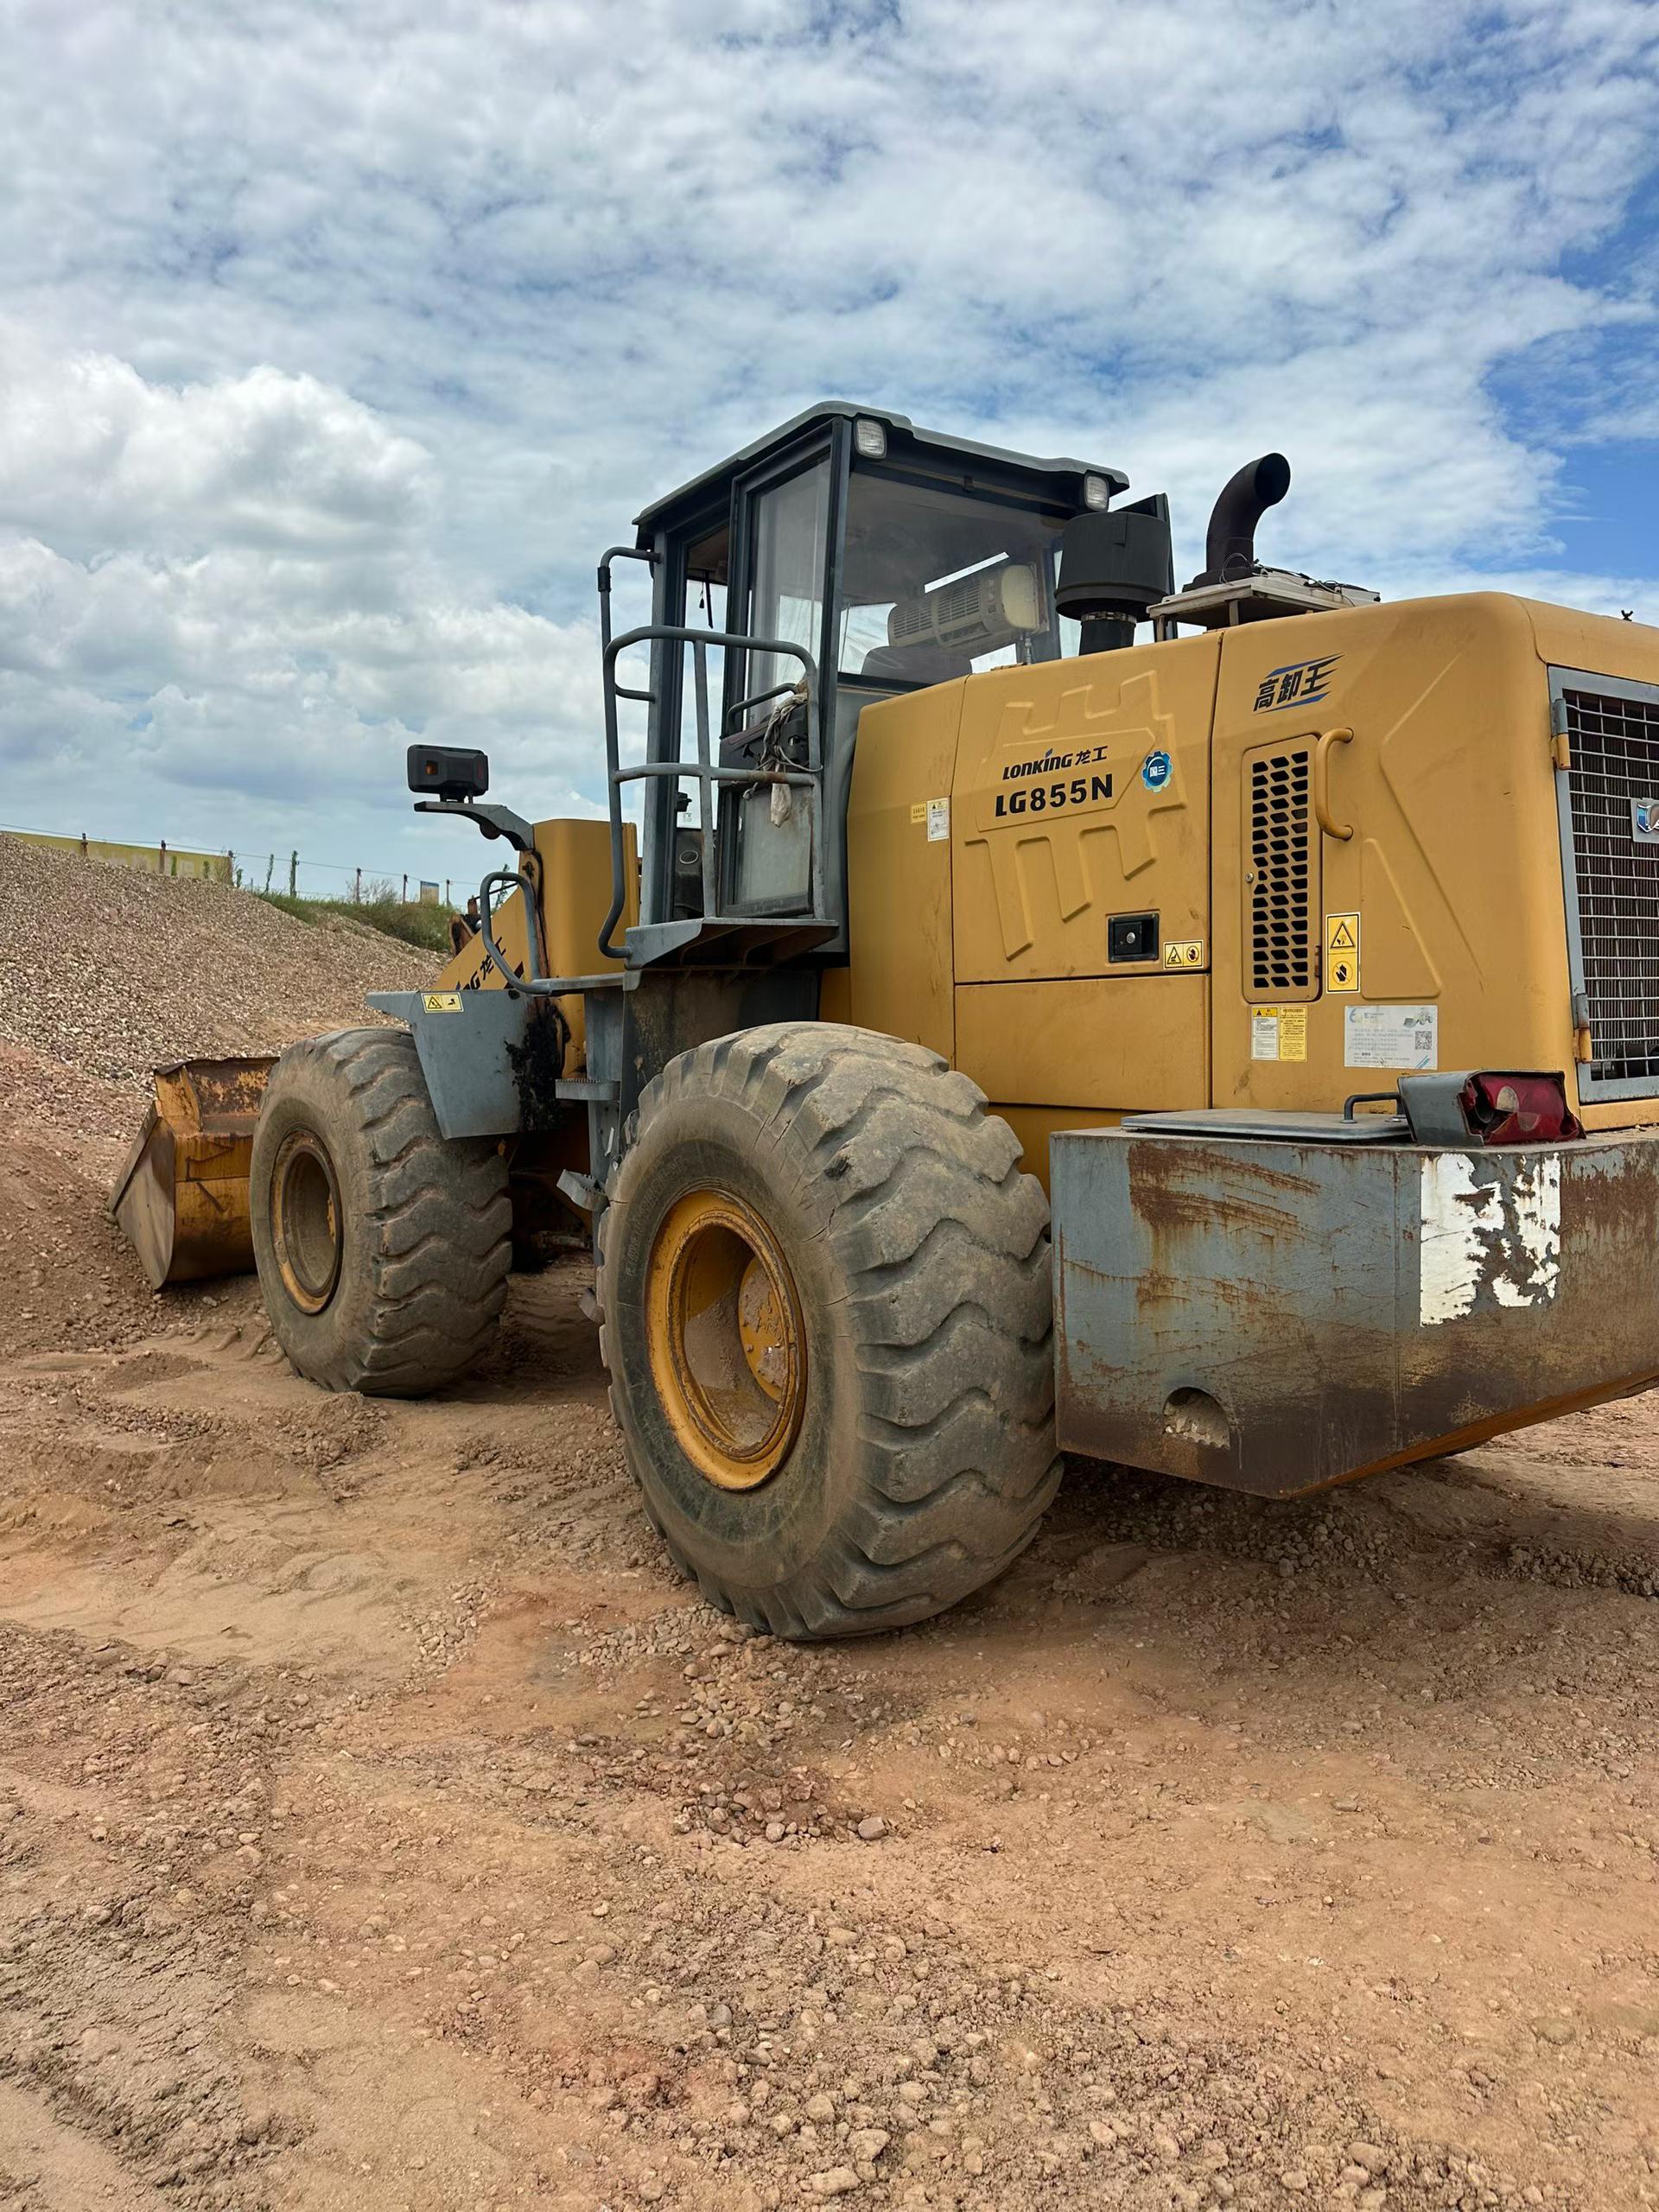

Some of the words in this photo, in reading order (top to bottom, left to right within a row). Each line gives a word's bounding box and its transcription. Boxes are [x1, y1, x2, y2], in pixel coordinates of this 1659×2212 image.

[1253, 654, 1345, 712] 高卸王
[1075, 746, 1108, 766] 龙工
[995, 773, 1113, 817] LG855N
